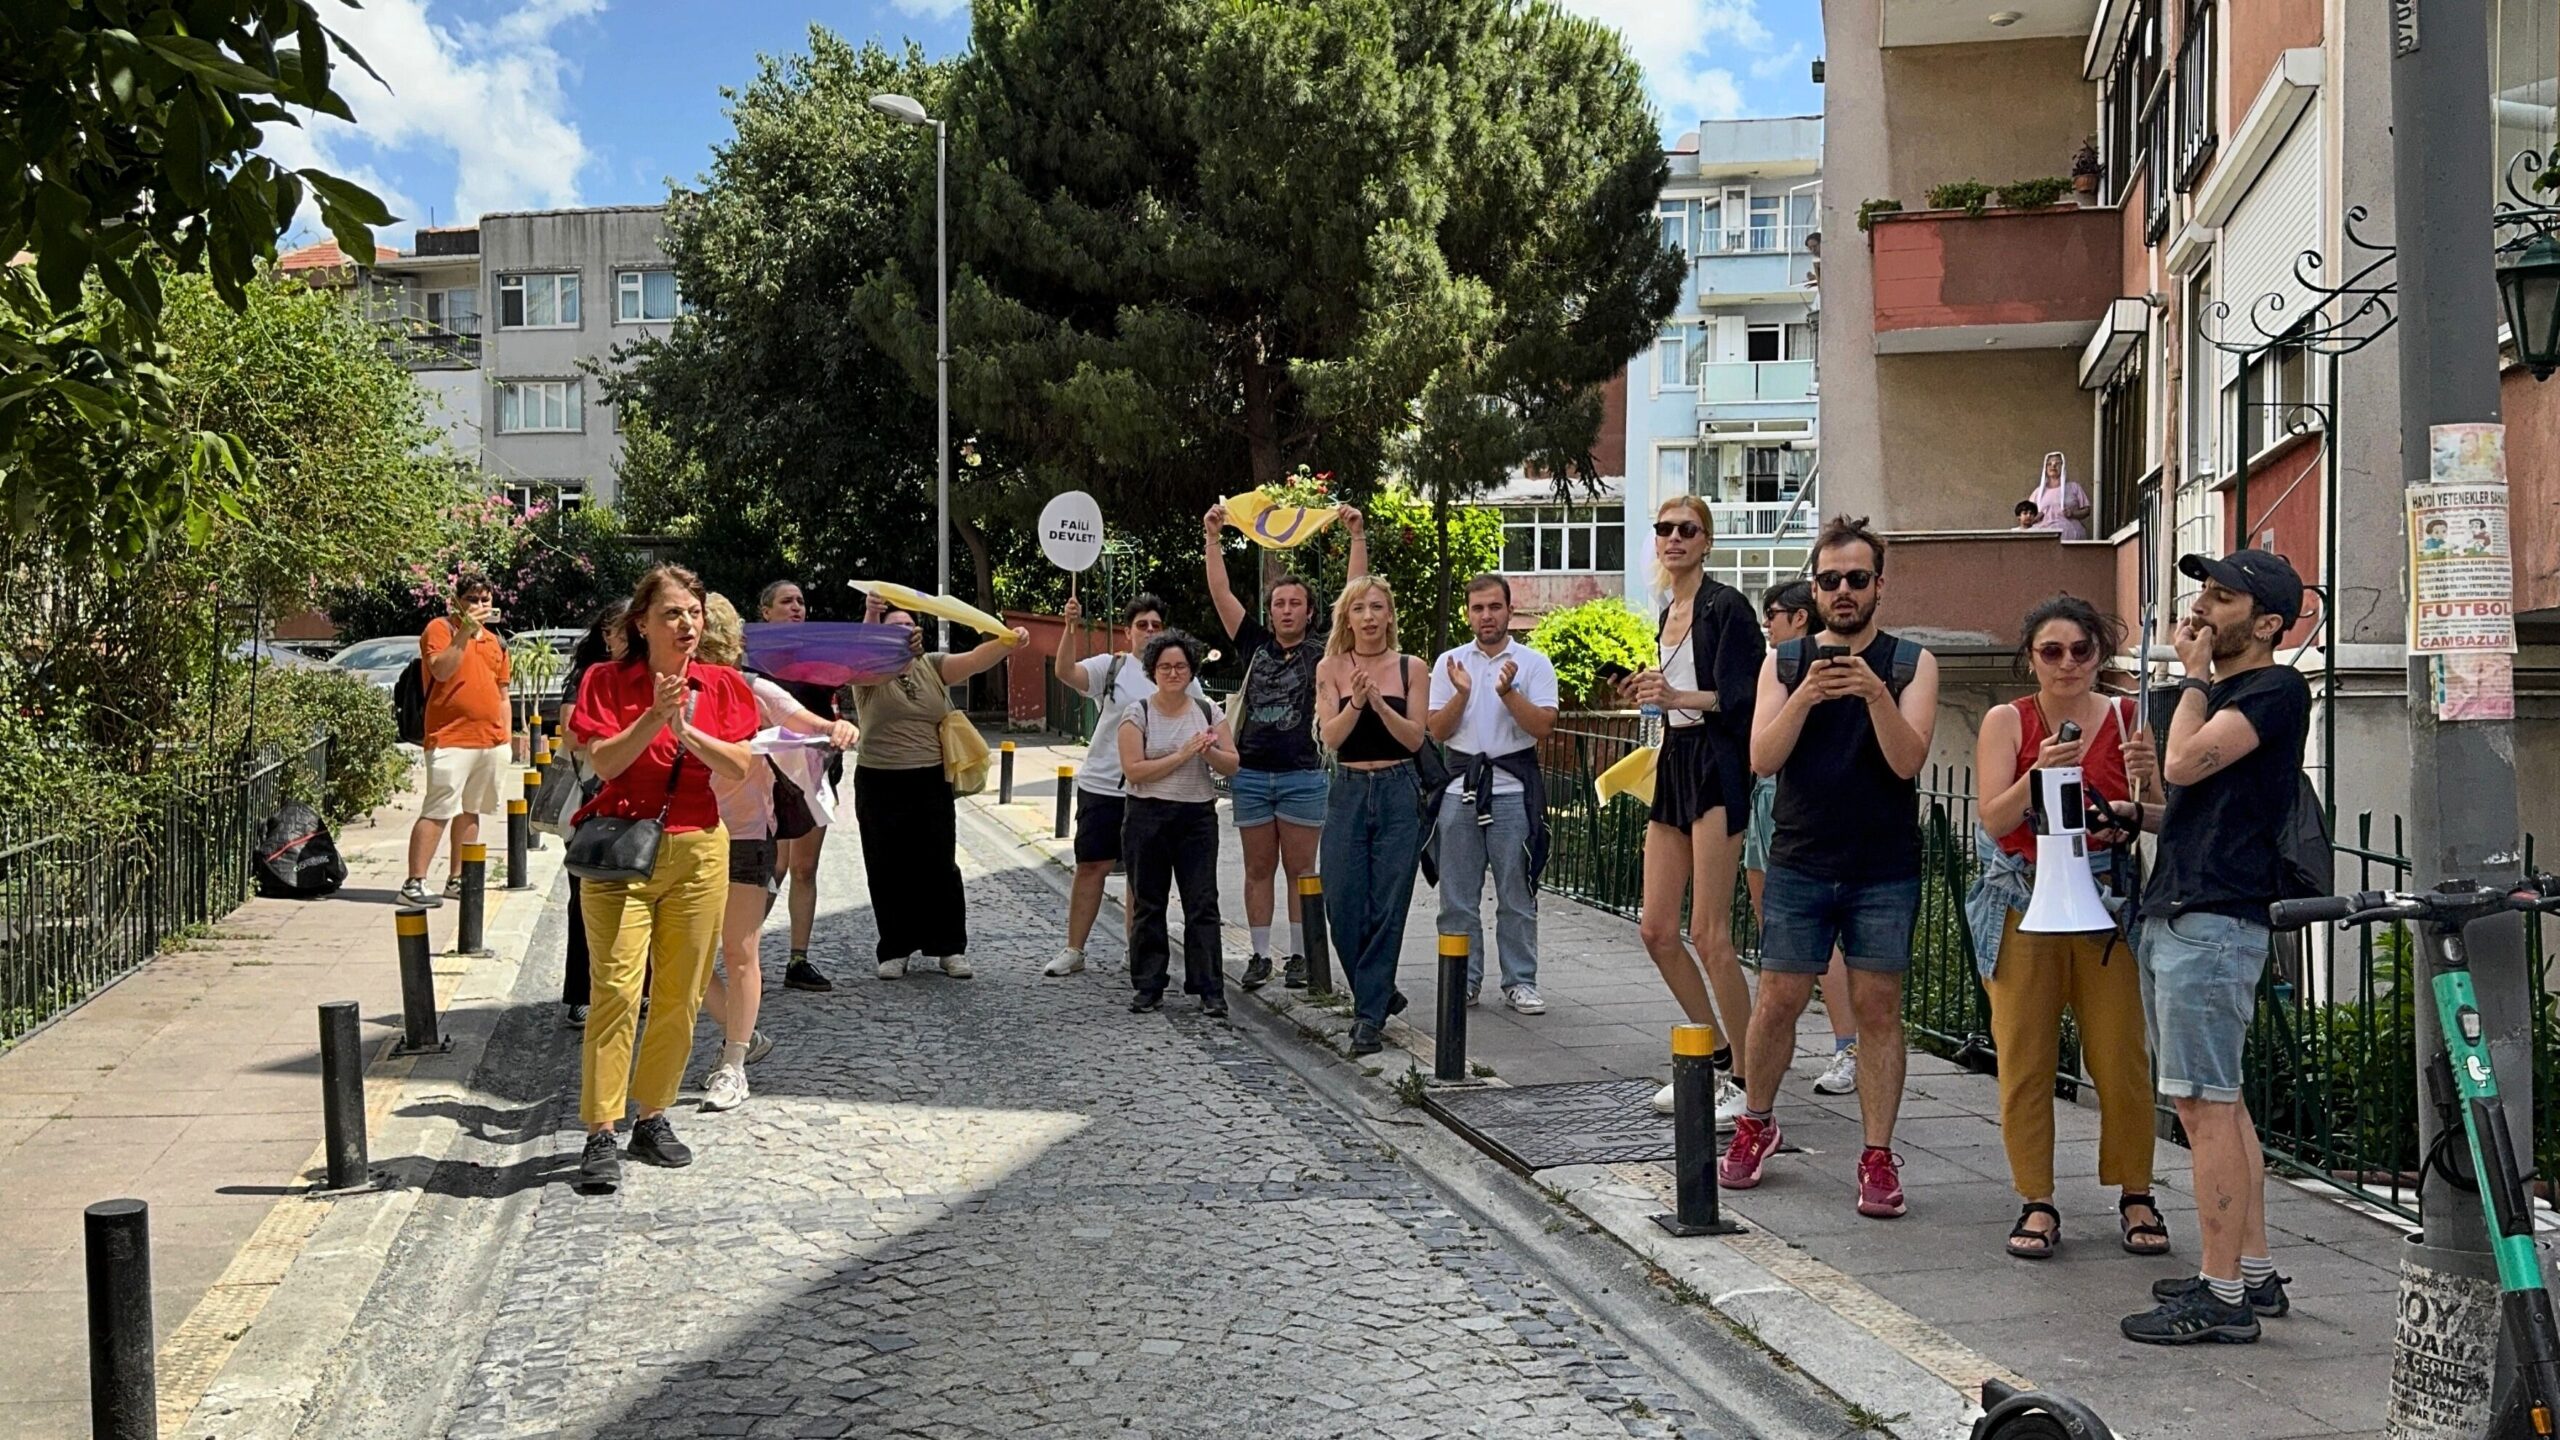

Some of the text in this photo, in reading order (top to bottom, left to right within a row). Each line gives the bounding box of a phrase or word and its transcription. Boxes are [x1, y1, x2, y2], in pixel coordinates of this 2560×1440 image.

[2412, 491, 2435, 508] HAYDİ
[2437, 491, 2489, 506] YETENEKLER
[1061, 519, 1089, 531] FAİLİ
[1049, 531, 1095, 543] DEVLET!
[2421, 602, 2512, 619] FUTBOL
[2420, 635, 2510, 647] CAMBAZLARI
